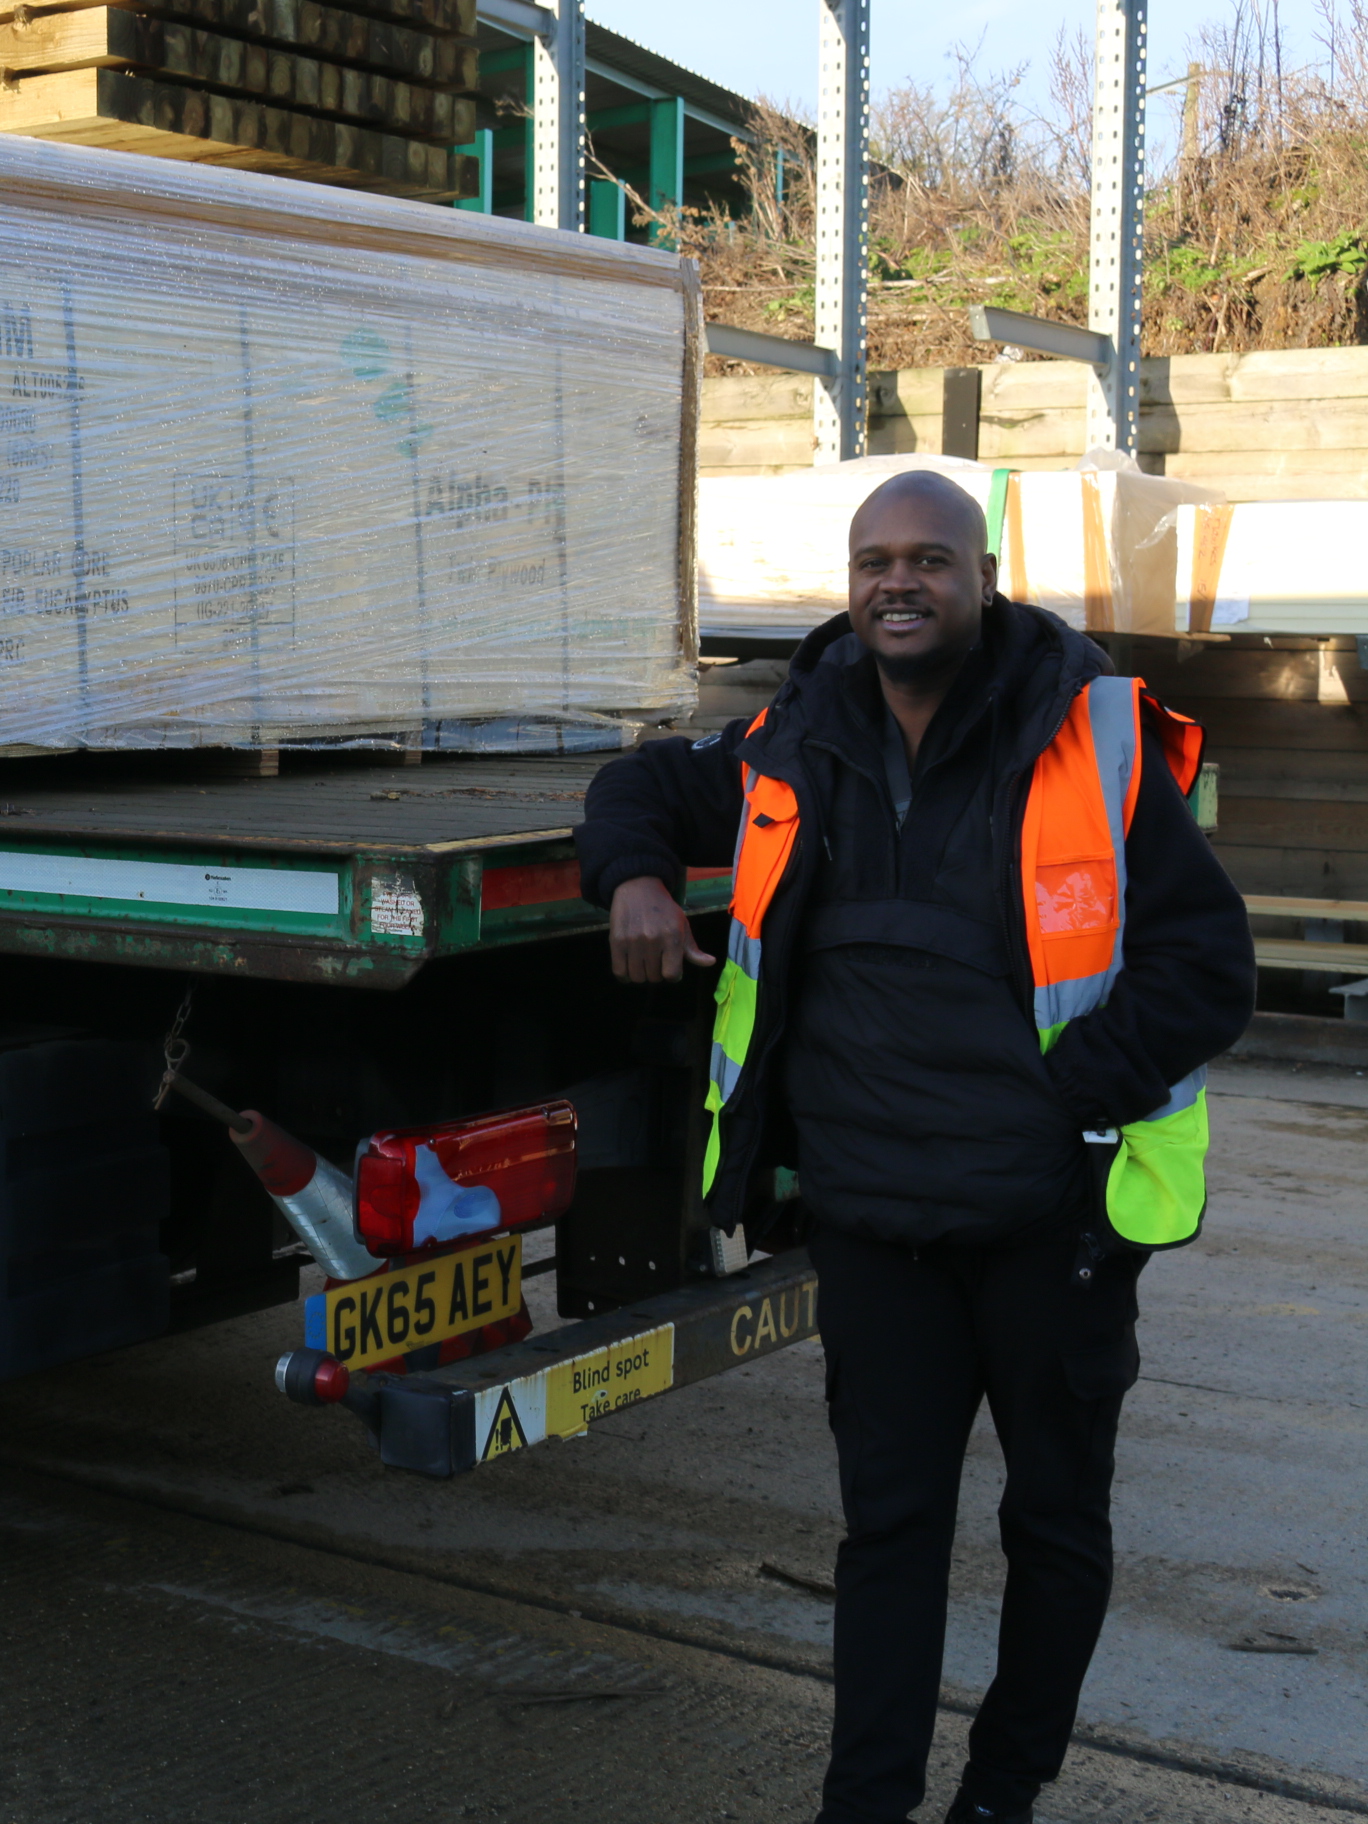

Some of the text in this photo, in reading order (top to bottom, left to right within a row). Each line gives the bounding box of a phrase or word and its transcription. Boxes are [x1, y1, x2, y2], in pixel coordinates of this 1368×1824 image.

[2, 549, 61, 576] POPLAR
[34, 588, 130, 615] EUCAYPTUS
[334, 1244, 517, 1363] GK65 AEY
[572, 1347, 650, 1394] Blind spot
[579, 1386, 642, 1423] Take care
